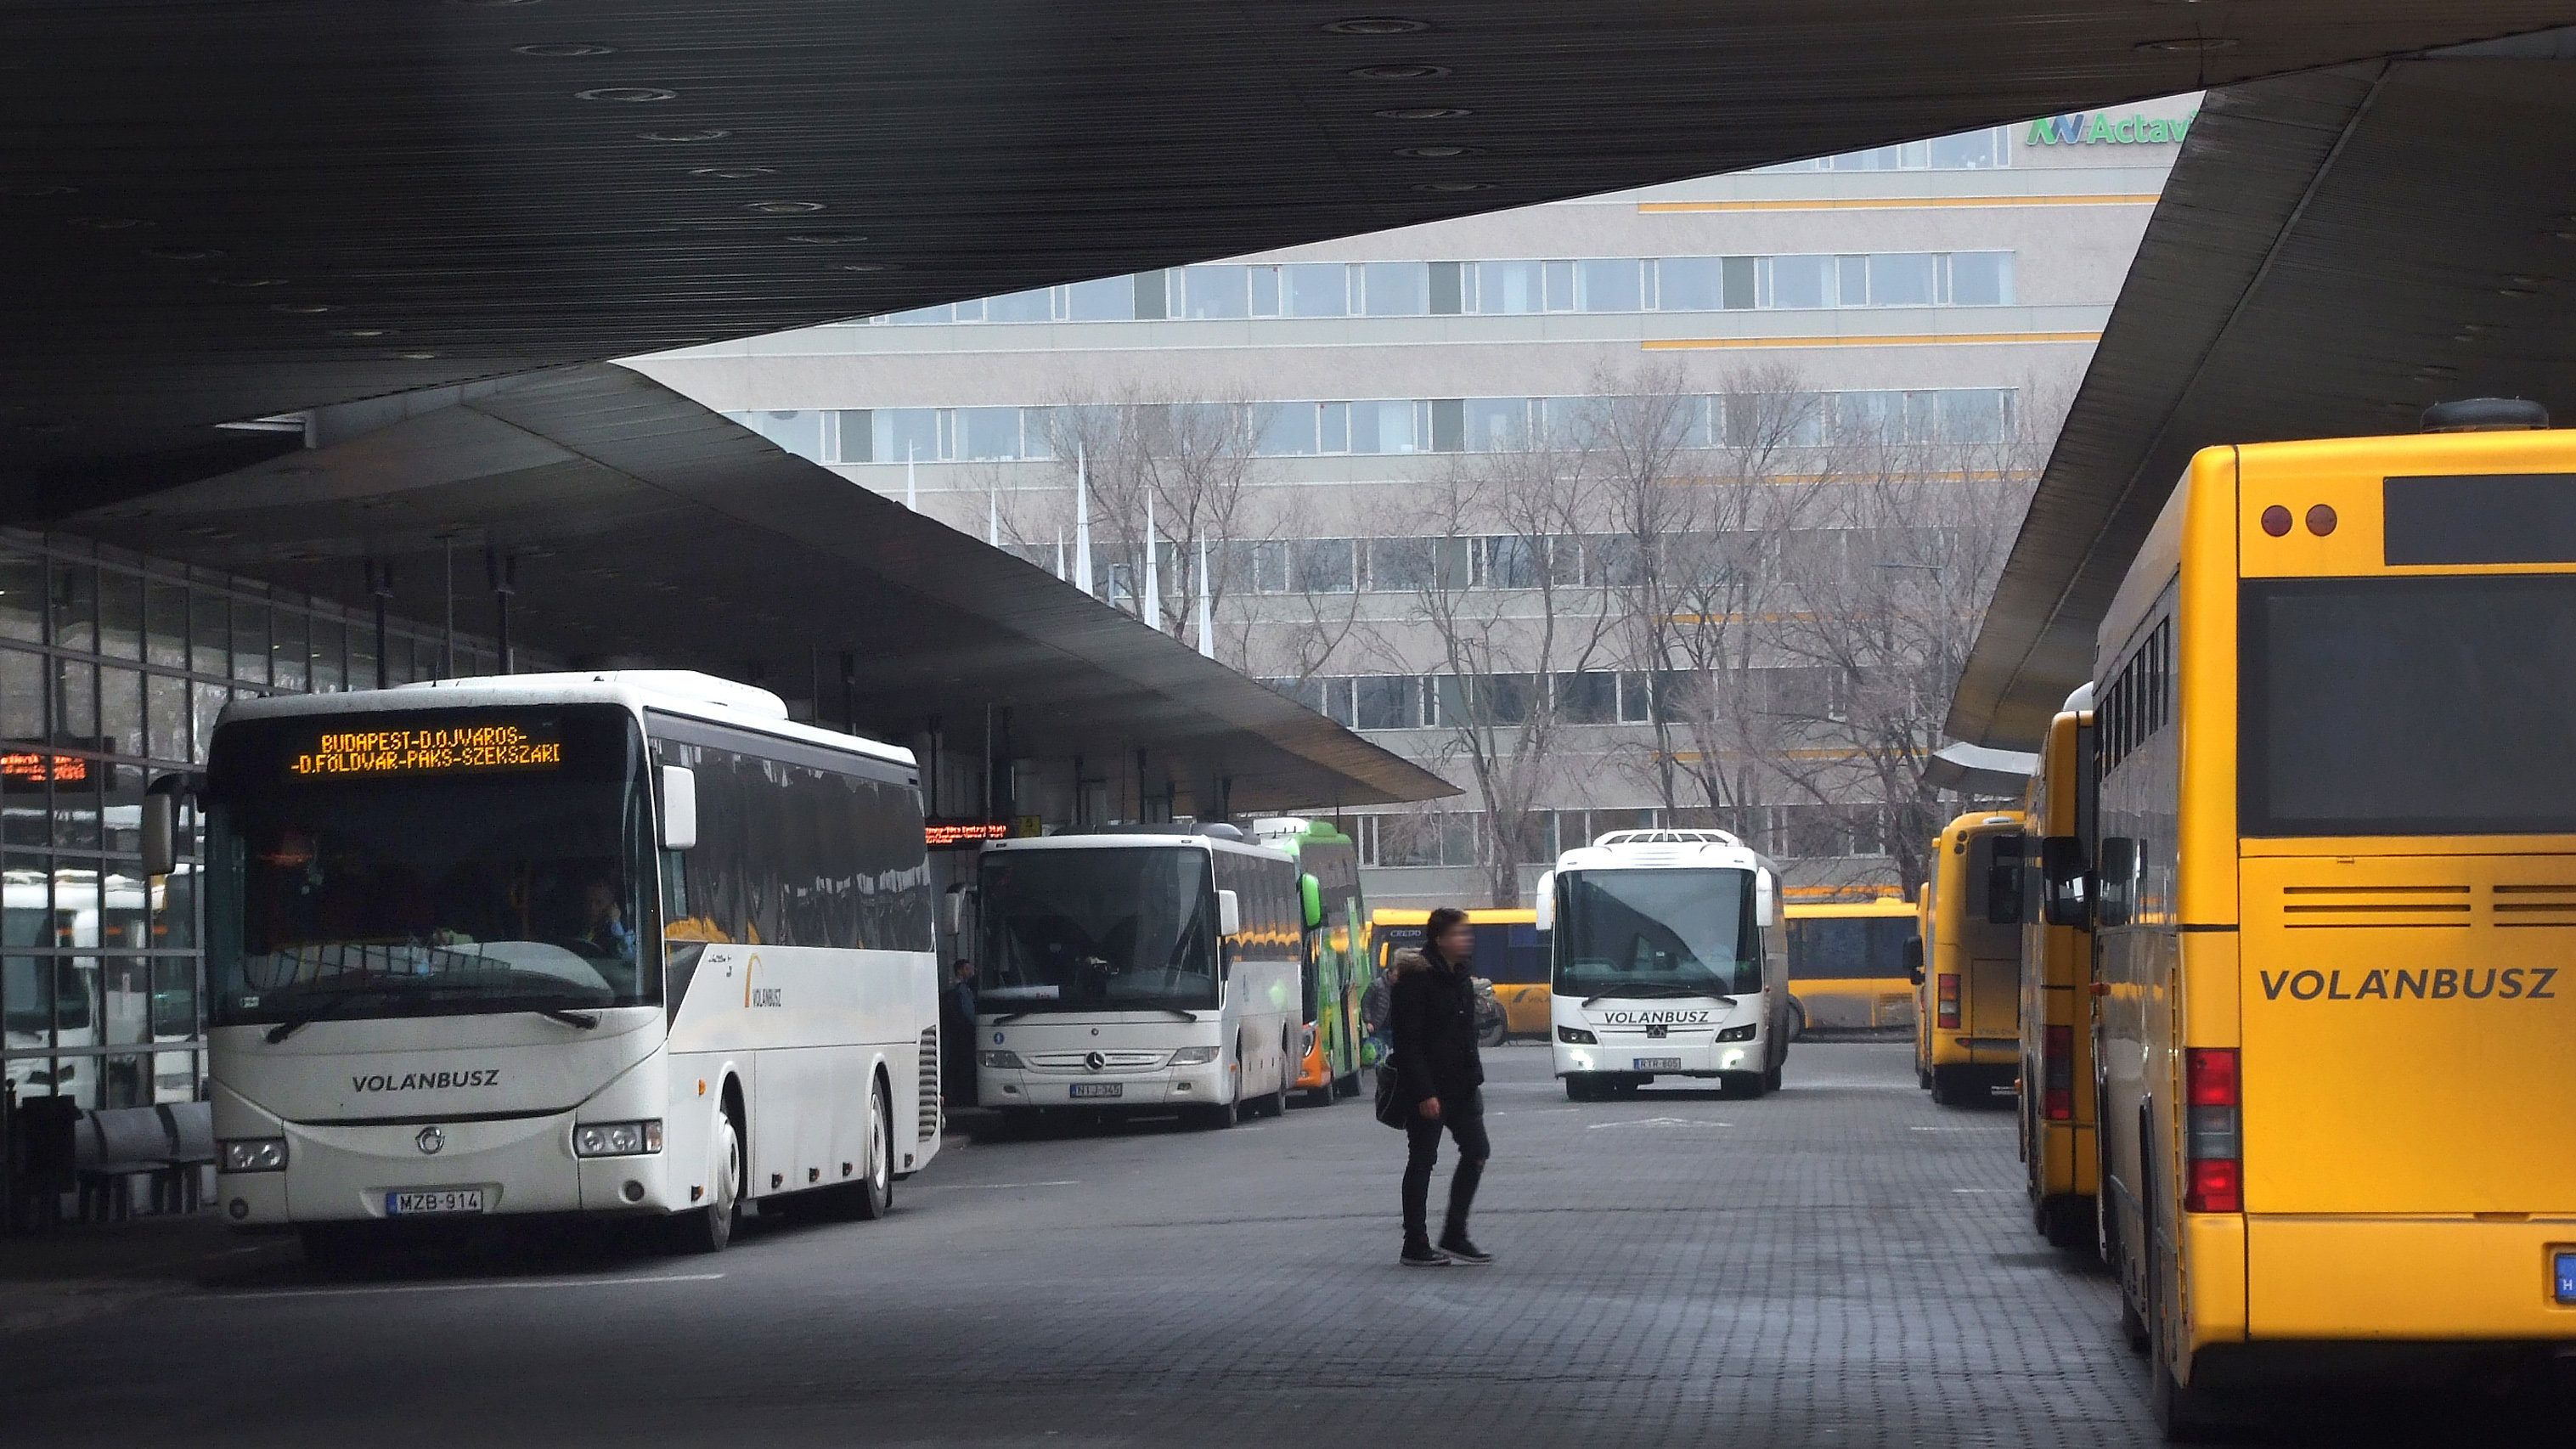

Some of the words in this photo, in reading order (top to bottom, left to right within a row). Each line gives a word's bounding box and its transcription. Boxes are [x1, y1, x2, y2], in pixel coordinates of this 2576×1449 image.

[2260, 968, 2558, 1000] VOLÁNBUSZ
[399, 1192, 477, 1211] MZB-914
[2562, 1278, 2573, 1291] H
